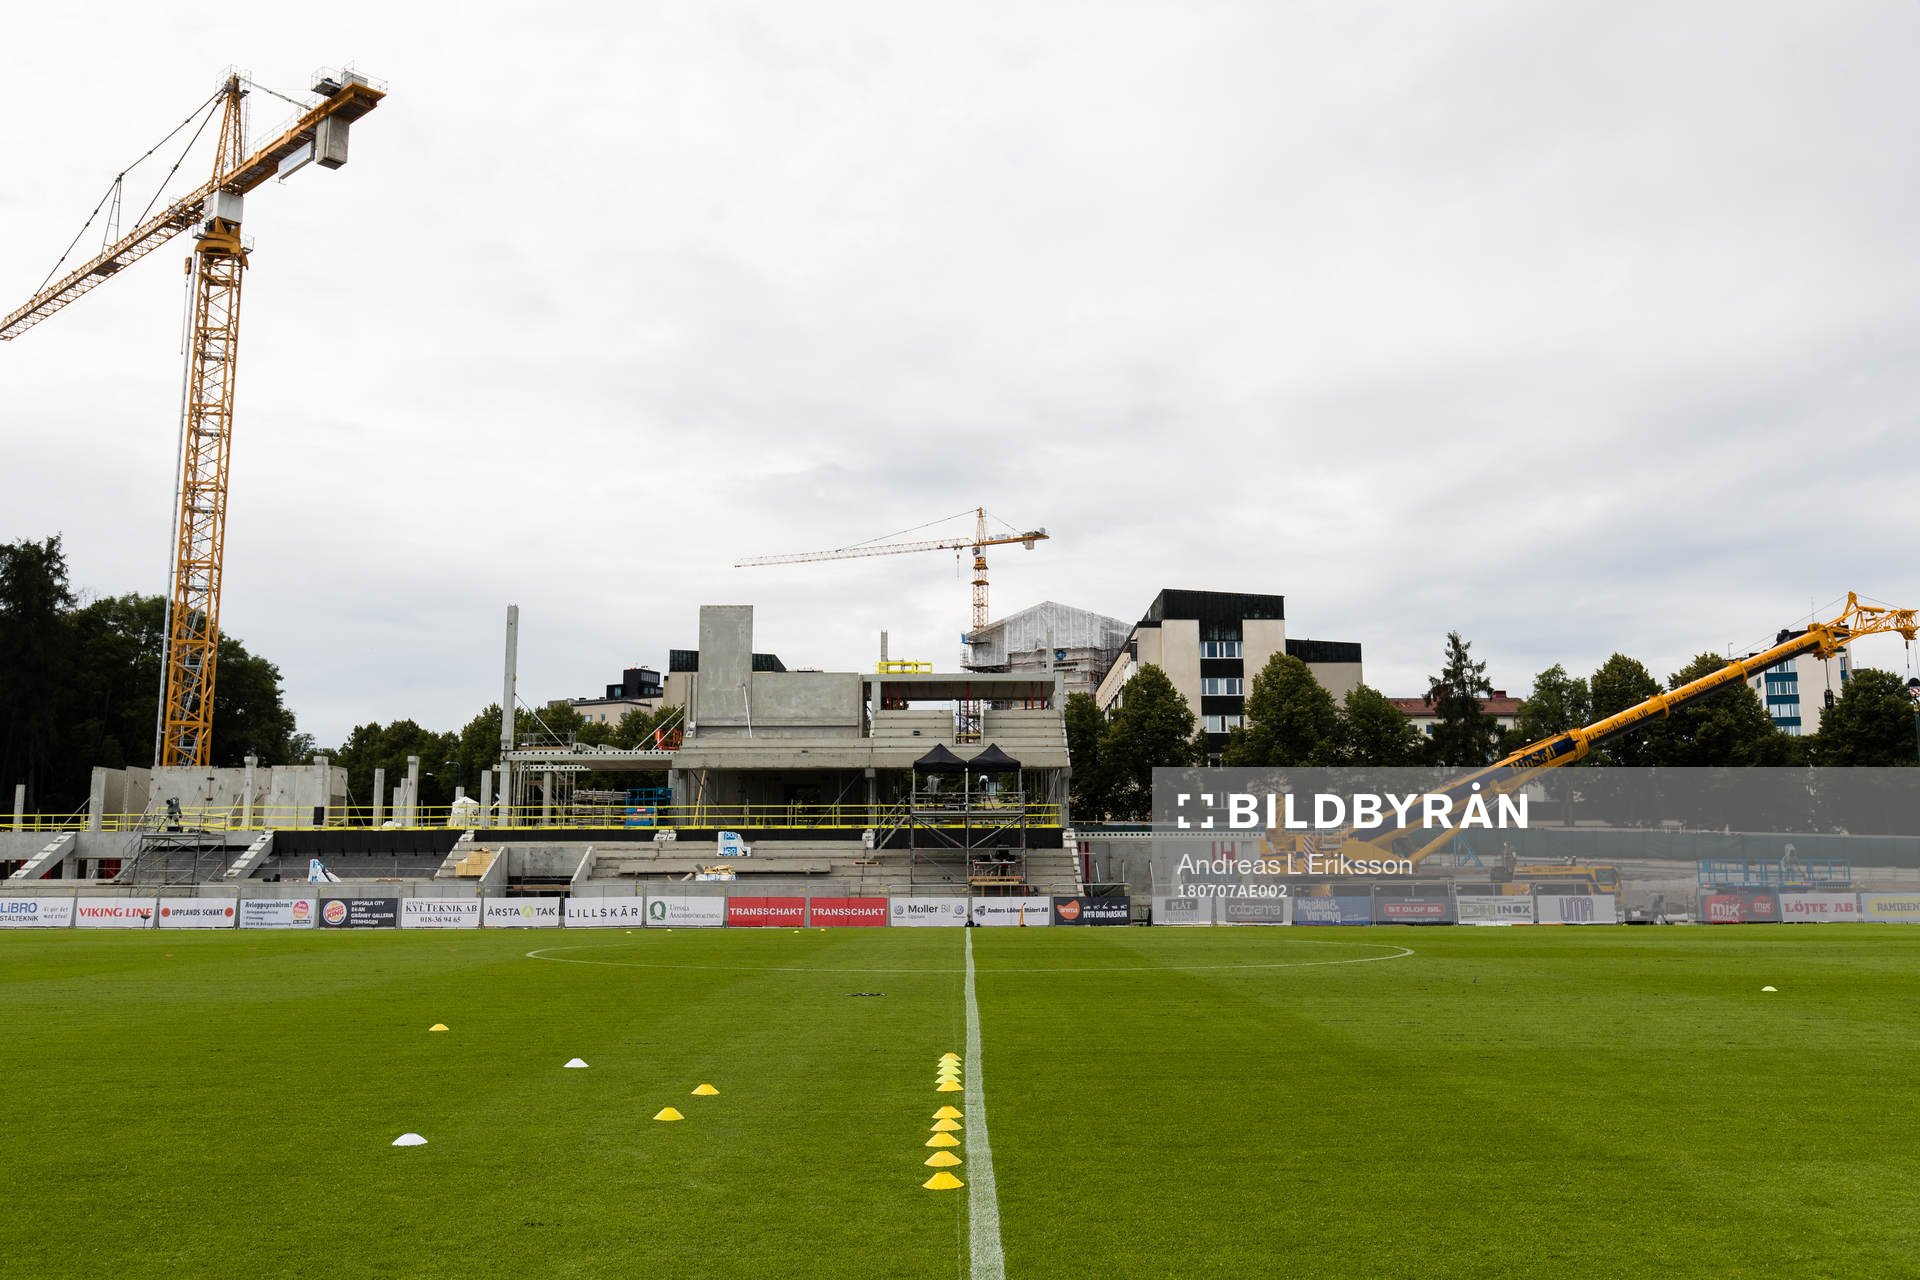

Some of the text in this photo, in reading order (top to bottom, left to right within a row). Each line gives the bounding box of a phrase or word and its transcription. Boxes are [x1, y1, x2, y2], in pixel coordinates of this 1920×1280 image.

[940, 903, 951, 913] Bil
[1171, 900, 1192, 910] PLÅT
[1228, 901, 1280, 915] colorama
[1497, 905, 1531, 914] INOX
[1710, 900, 1740, 916] mix
[1754, 901, 1772, 910] mix
[1784, 900, 1854, 915] LÖJTE AB
[79, 907, 153, 918] VIKING LINE
[171, 908, 224, 916] UPPLANDS SCHAKT
[326, 907, 345, 919] KING
[487, 906, 556, 916] ÅRSTA TAK
[729, 907, 804, 916] TRANSSCHAKT
[811, 908, 886, 916] TRANSSCHAKT
[1083, 910, 1128, 919] HYR DIN MASKIN
[1306, 910, 1341, 923] Verktyg
